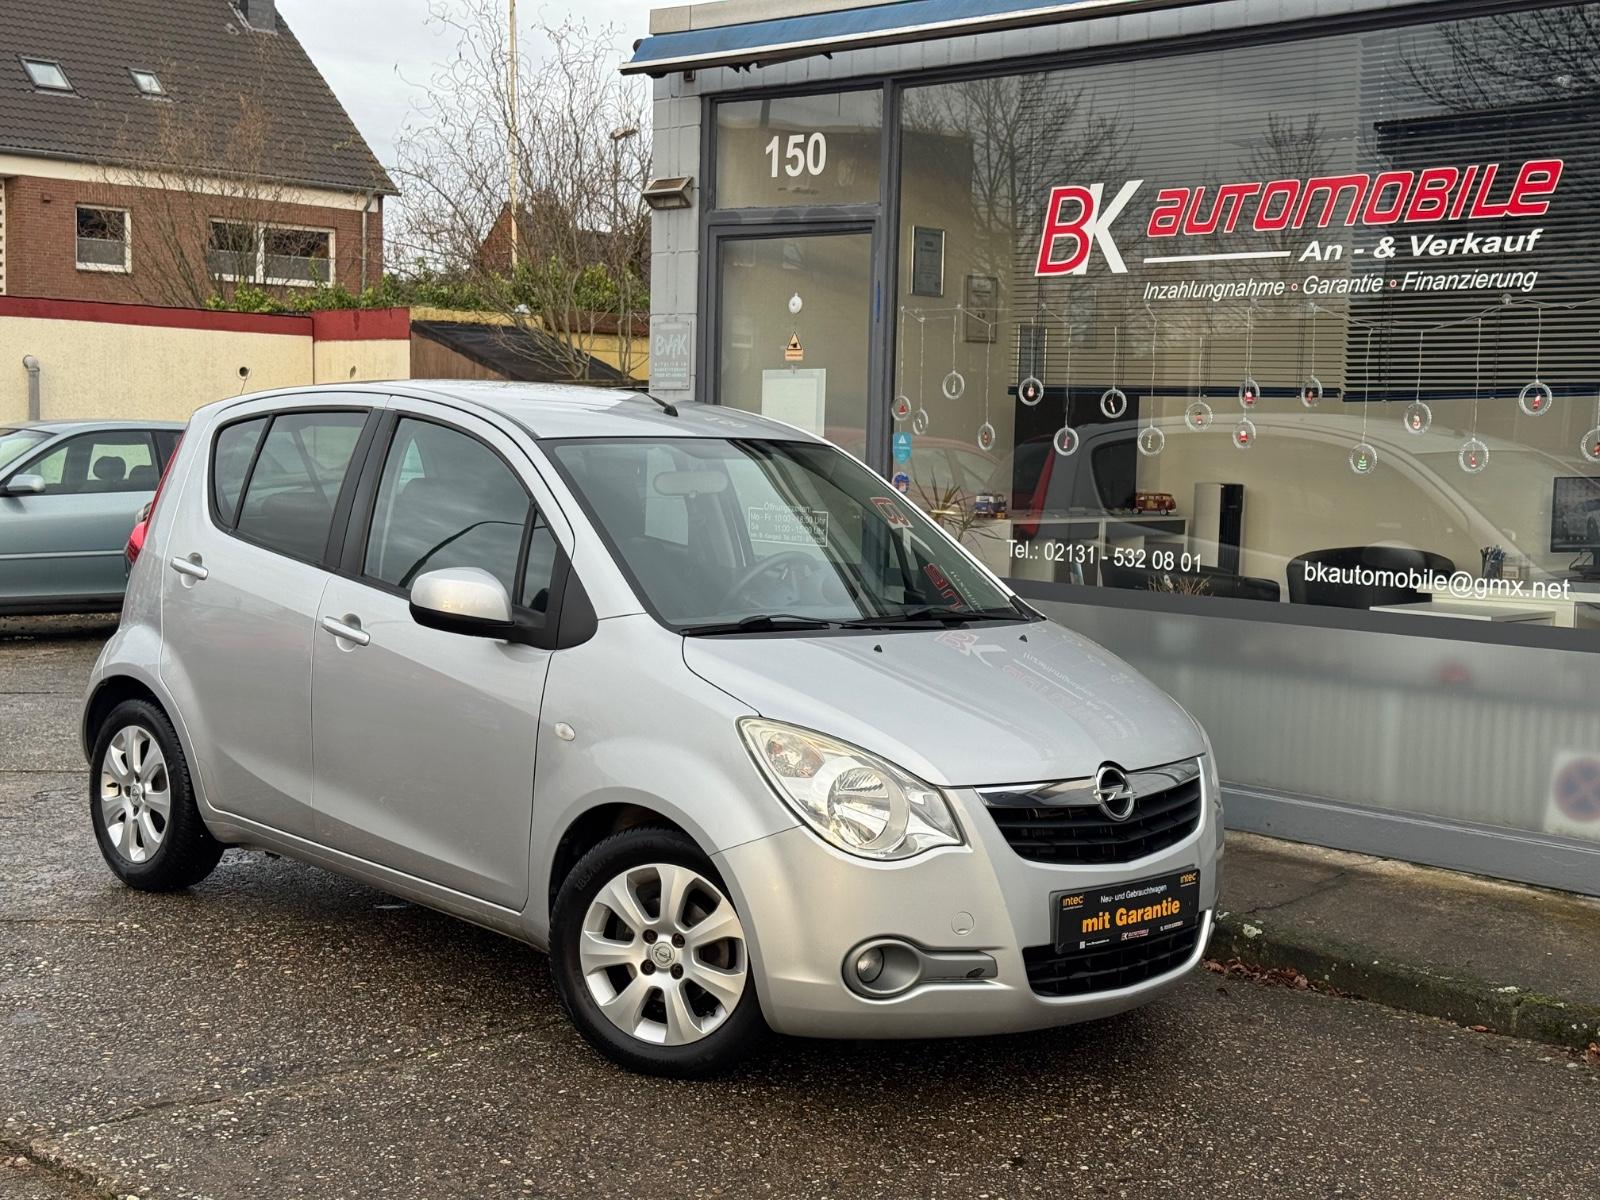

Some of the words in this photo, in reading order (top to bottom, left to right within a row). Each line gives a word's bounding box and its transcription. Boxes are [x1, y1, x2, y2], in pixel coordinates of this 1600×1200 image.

[765, 132, 827, 178] 150
[1034, 179, 1144, 277] BK
[1298, 240, 1343, 262] An
[1373, 236, 1396, 259] &
[1410, 229, 1544, 257] Verkauf
[1143, 278, 1286, 303] Inzahlungnahme
[1302, 273, 1384, 295] Garantie
[1401, 269, 1539, 293] Finanzierung
[1006, 539, 1038, 560] Tel.:
[1044, 542, 1095, 565] 02131
[1113, 547, 1147, 568] 532
[1152, 550, 1175, 571] 08
[1180, 552, 1202, 573] 01
[1304, 560, 1571, 601] bkautomobile@gmx.net
[1062, 895, 1084, 907] intec
[1100, 894, 1114, 903] Neu-
[1114, 891, 1125, 901] und
[1125, 884, 1168, 899] Gebrauchtwagen
[1082, 911, 1110, 933] mit
[1115, 897, 1181, 926] Garantie
